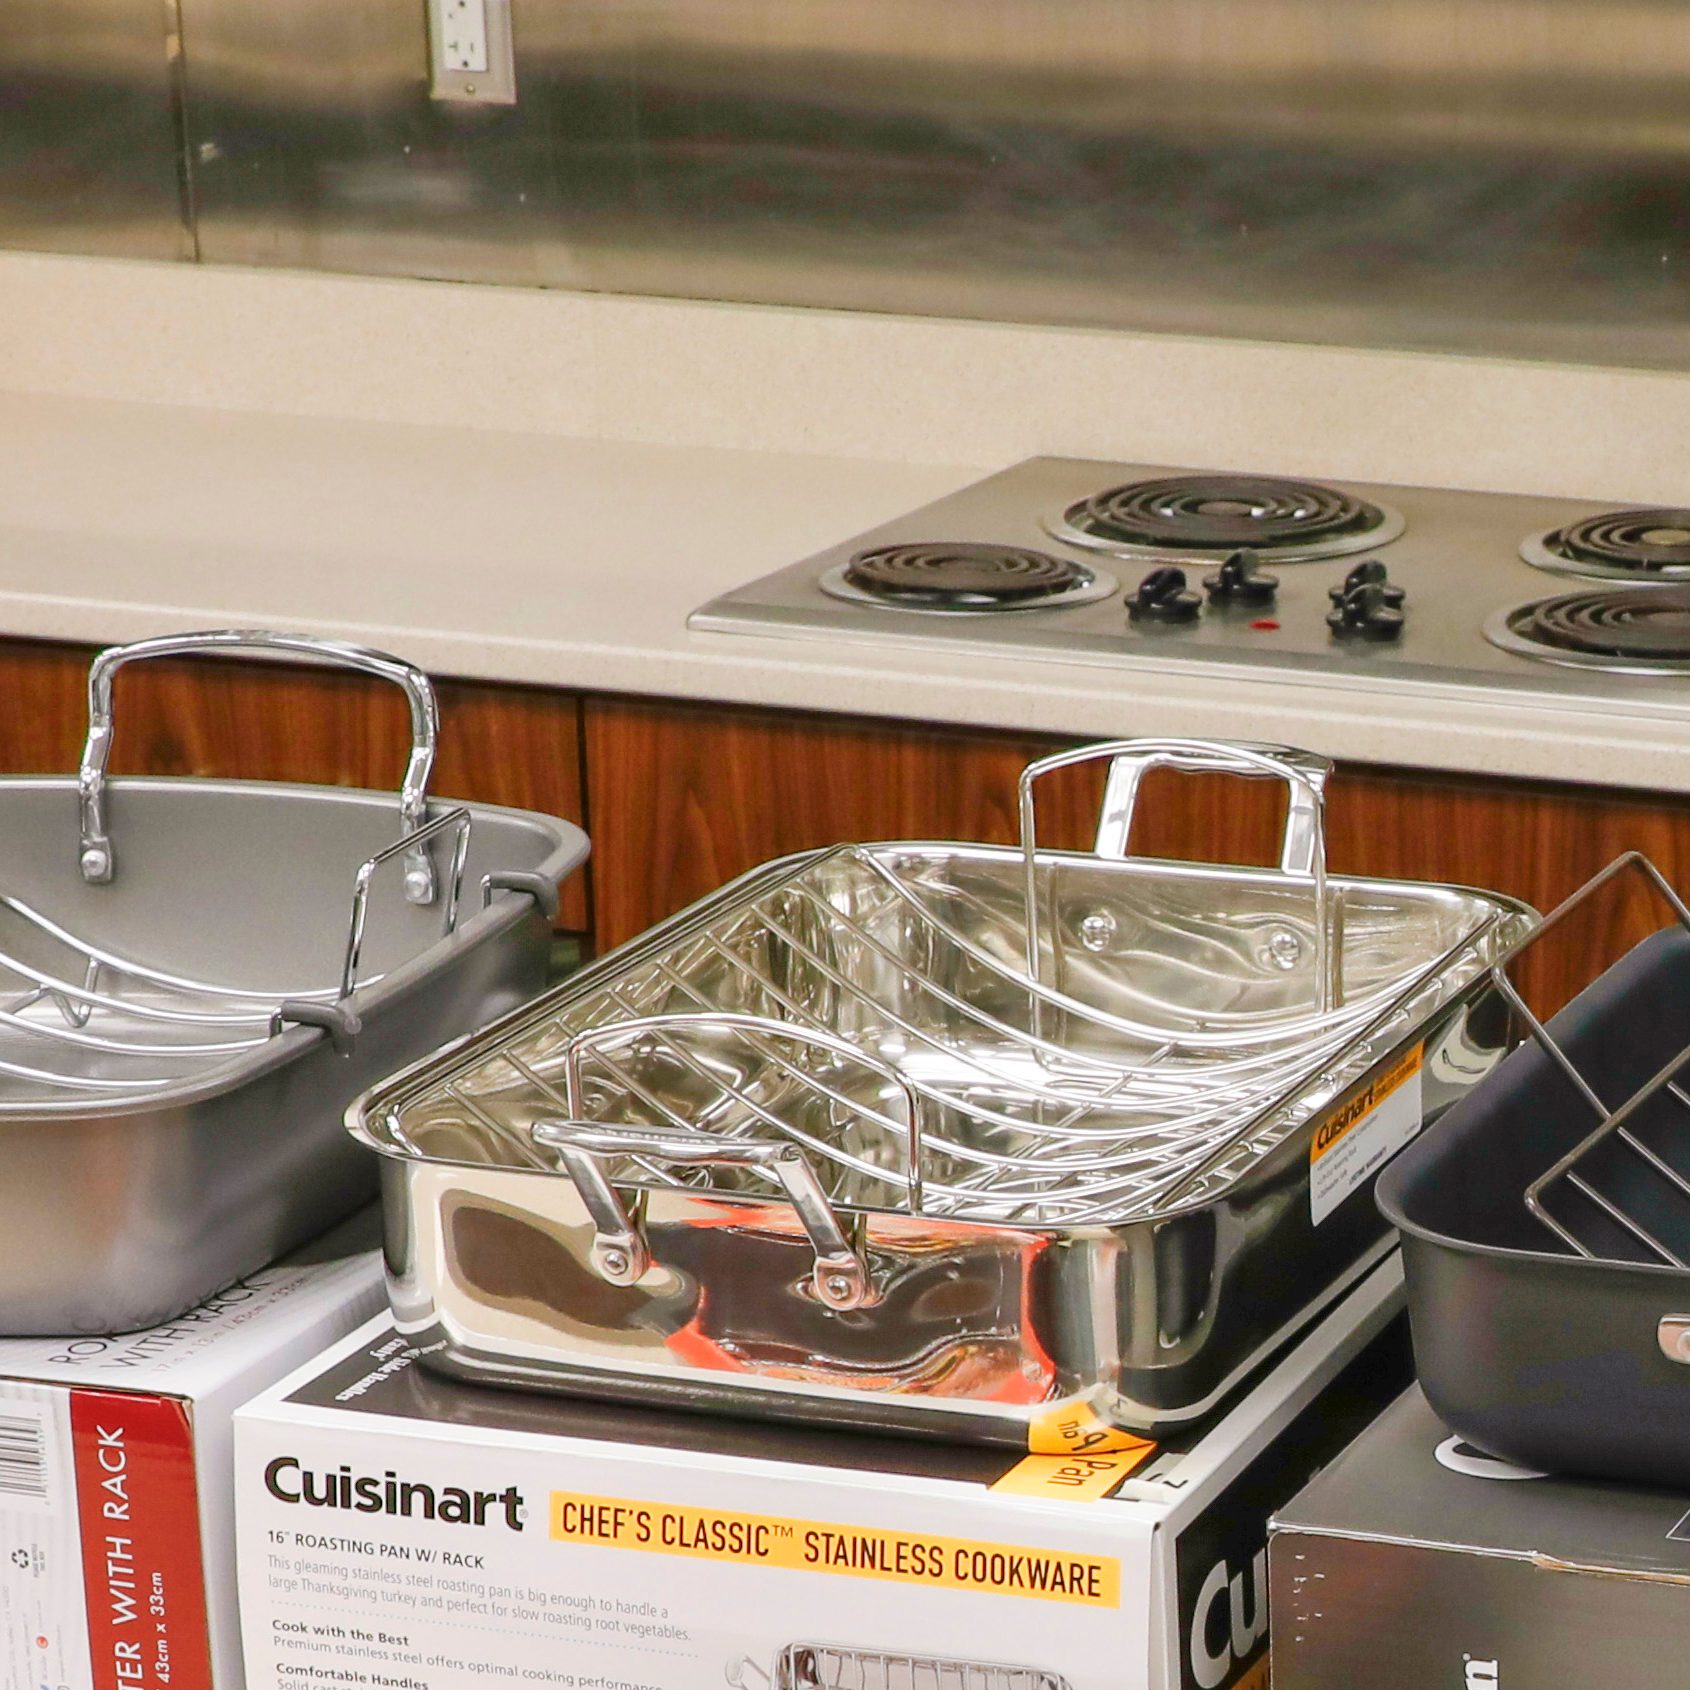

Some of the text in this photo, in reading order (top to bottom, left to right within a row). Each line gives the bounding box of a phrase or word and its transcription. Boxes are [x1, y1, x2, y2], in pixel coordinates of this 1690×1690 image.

[100, 1327, 195, 1368] WITH
[96, 1425, 130, 1520] RACK
[264, 1456, 525, 1532] Cuisinart
[1047, 1459, 1117, 1487] Pan
[295, 1534, 374, 1556] ROASTING
[380, 1544, 410, 1561] PAN
[415, 1549, 438, 1564] W/
[443, 1552, 485, 1570] RACK
[562, 1501, 652, 1543] CHEF'S
[803, 1531, 944, 1579] STAINLESS
[953, 1549, 1102, 1599] COOKWARE
[105, 1536, 138, 1625] WITH
[150, 1572, 165, 1616] 33cm
[268, 1554, 669, 1619] This gleaming stainless steel roasting pan is big enough to handle a
[156, 1623, 167, 1633] x
[272, 1619, 409, 1646] Cook with the Best
[155, 1639, 171, 1683] 43cm
[274, 1635, 331, 1653] Premium
[335, 1643, 389, 1661] stainless
[392, 1649, 422, 1665] steel
[426, 1655, 464, 1671] offers
[468, 1662, 518, 1678] optimal
[522, 1669, 574, 1687] cooking
[276, 1663, 429, 1690] Comfortable Handles
